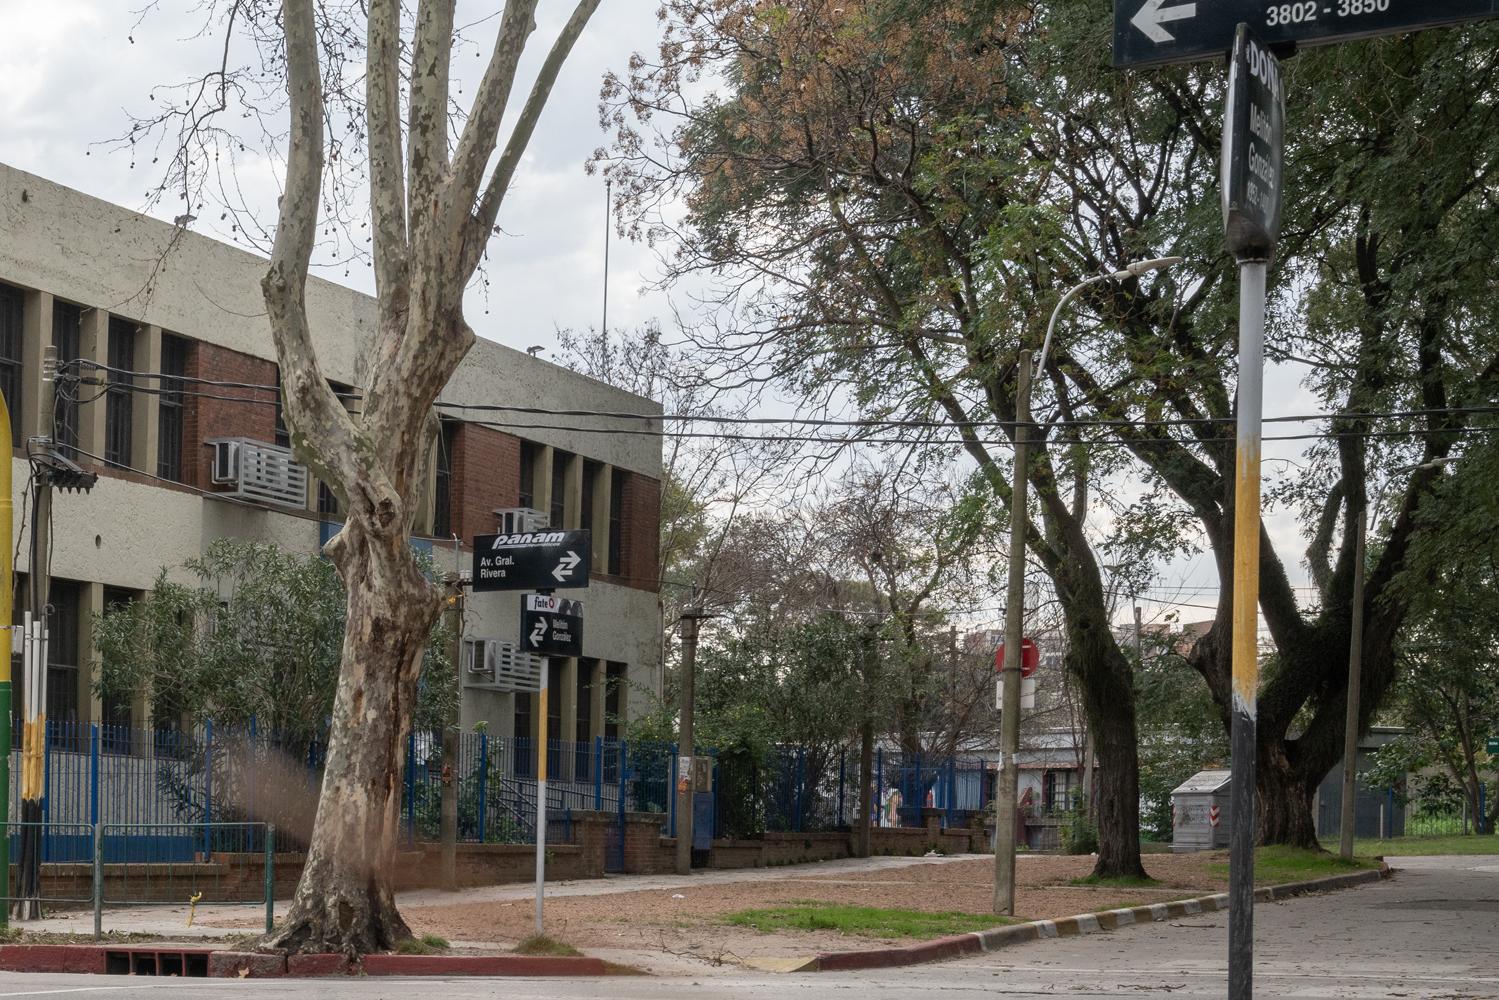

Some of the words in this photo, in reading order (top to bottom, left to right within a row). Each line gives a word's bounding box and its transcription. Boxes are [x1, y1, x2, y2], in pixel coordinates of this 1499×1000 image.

[1266, 6, 1317, 26] 3802
[1337, 0, 1390, 17] 3850
[480, 557, 493, 567] Av.
[495, 555, 515, 566] Gral.
[480, 568, 506, 579] Rivera
